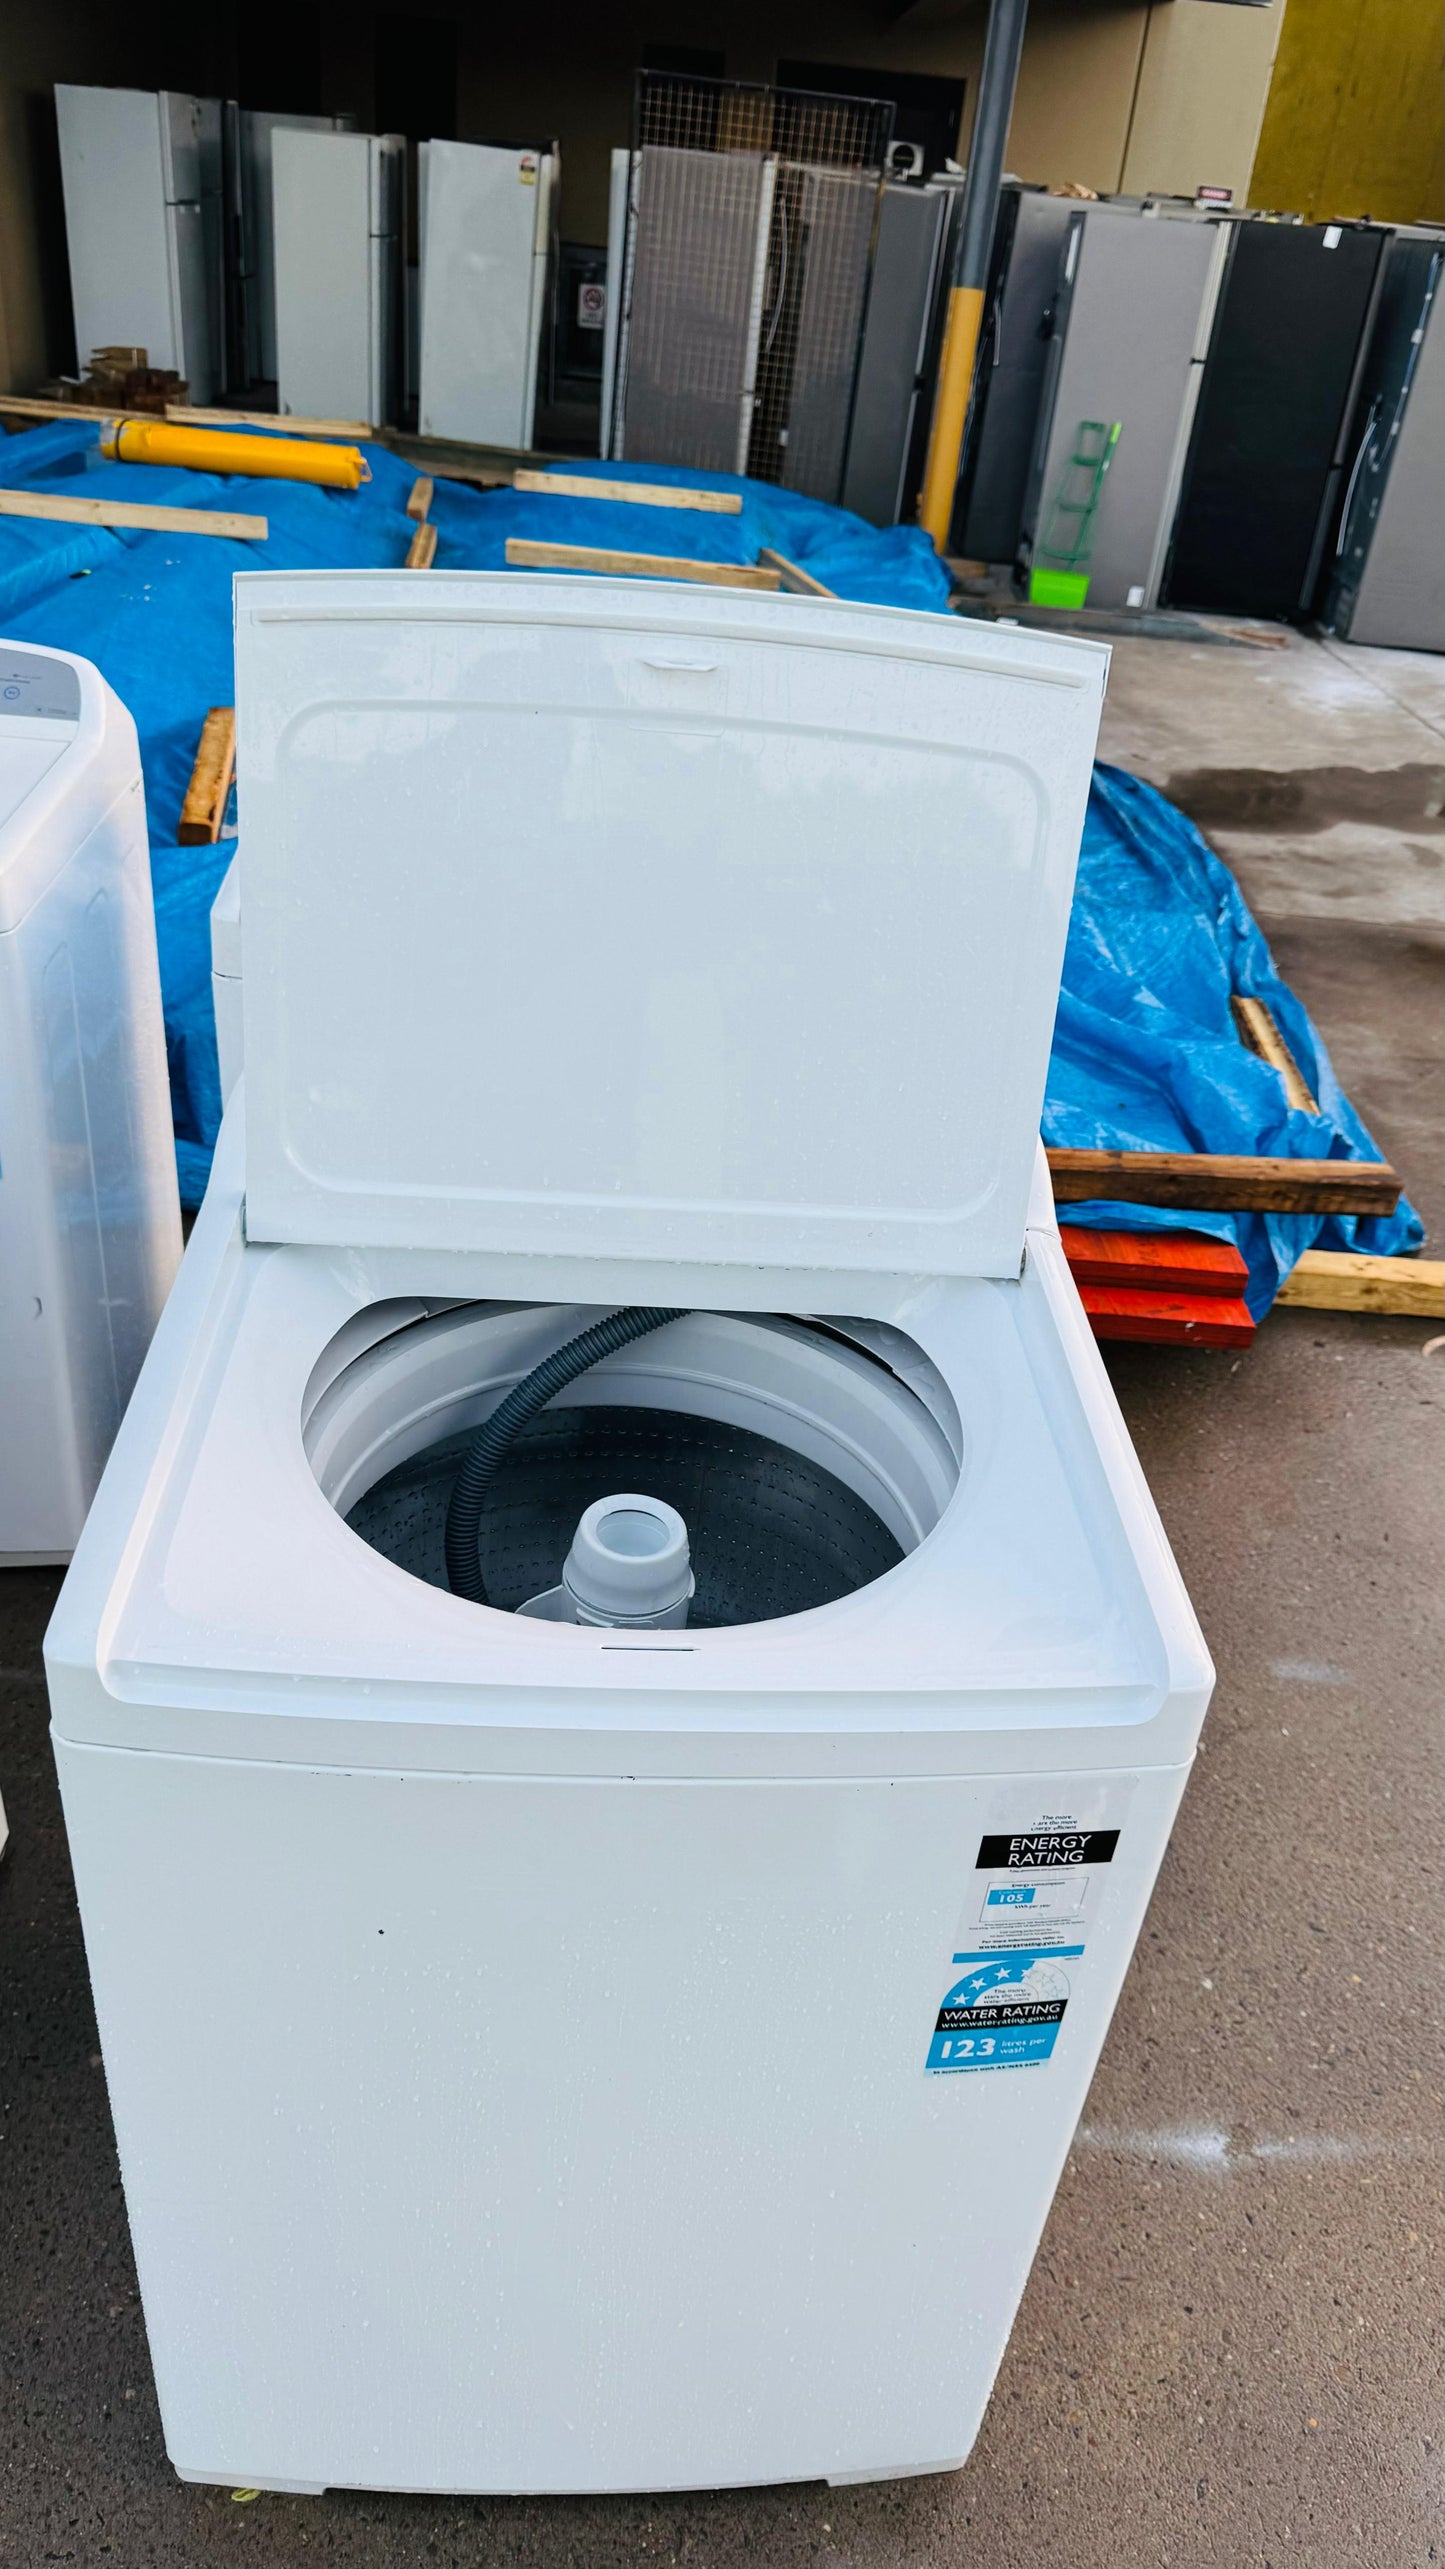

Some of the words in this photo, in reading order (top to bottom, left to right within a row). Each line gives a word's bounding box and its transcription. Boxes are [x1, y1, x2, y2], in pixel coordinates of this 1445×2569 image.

[1009, 1835, 1092, 1851] ENERGY
[1008, 1850, 1085, 1866] RATING
[1000, 1893, 1024, 1903] 105
[944, 2008, 998, 2020] WATER
[1002, 2003, 1060, 2017] RATING
[941, 2014, 1058, 2028] www.waterrating.gov.au
[941, 2037, 996, 2059] 123
[1029, 2039, 1047, 2047] per
[1000, 2046, 1025, 2054] wash
